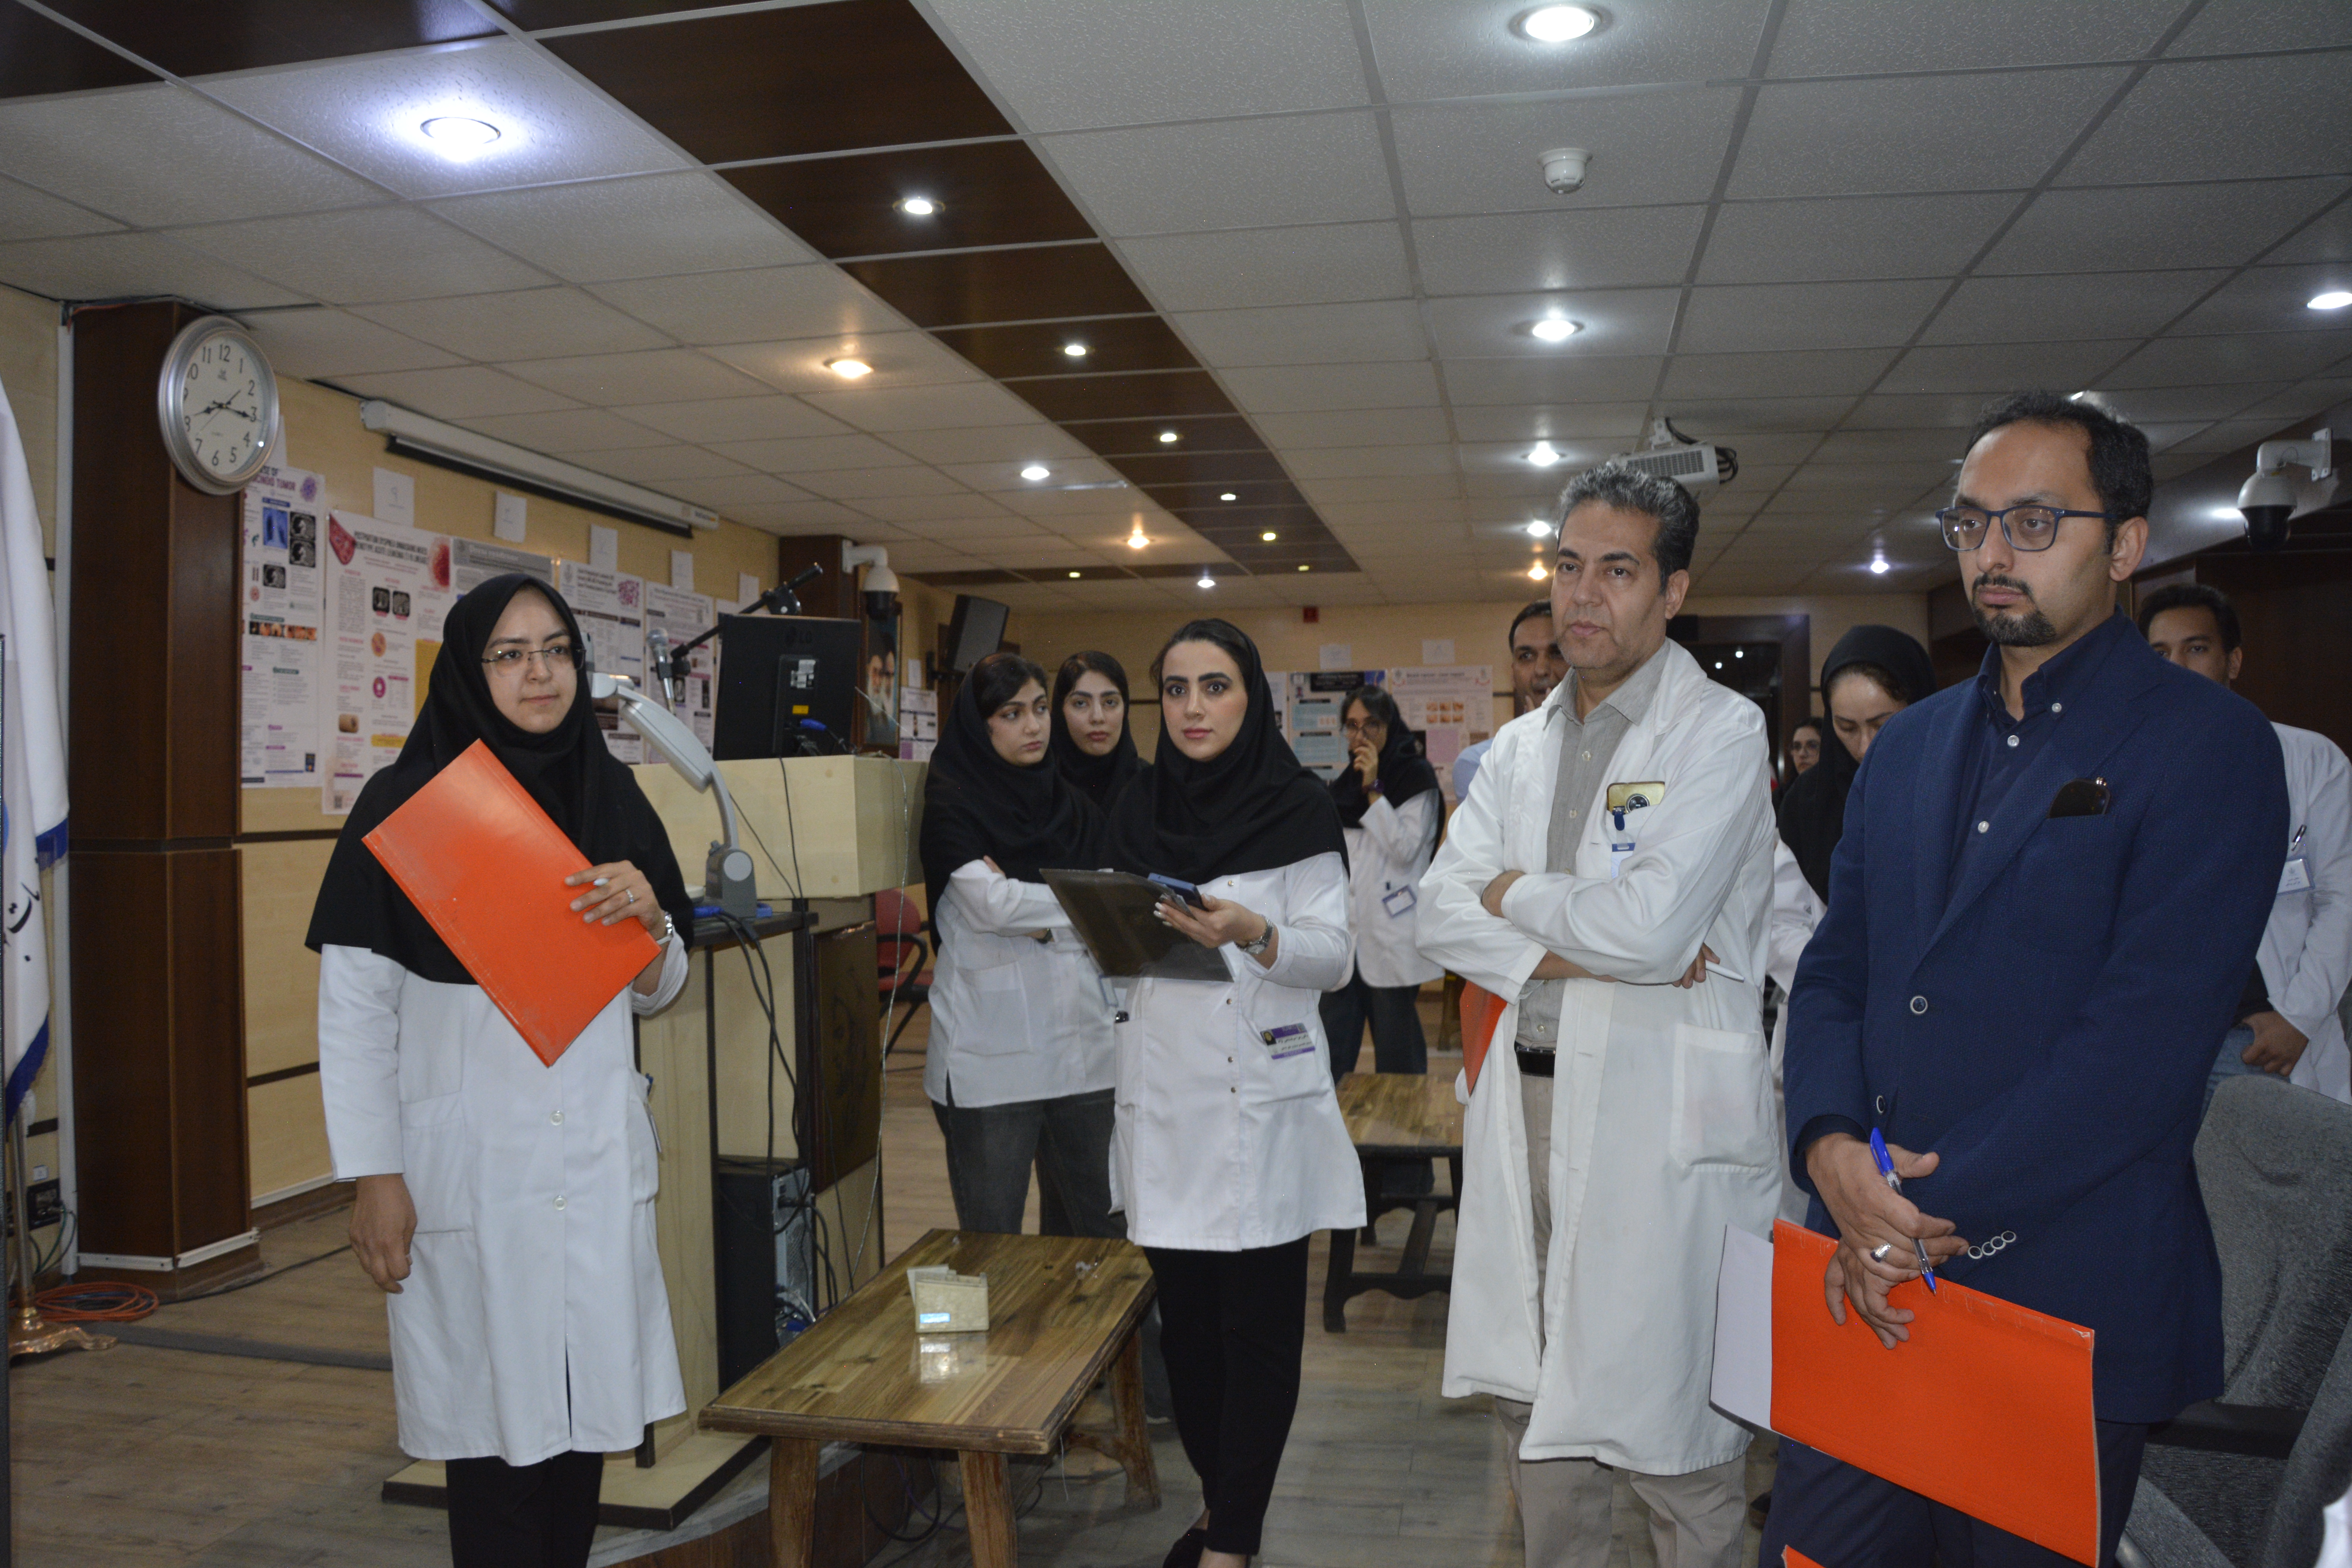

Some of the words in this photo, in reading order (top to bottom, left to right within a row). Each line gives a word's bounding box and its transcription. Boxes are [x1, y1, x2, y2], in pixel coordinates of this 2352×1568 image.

[203, 346, 211, 364] 11
[219, 344, 230, 362] 12
[187, 363, 198, 379] 10
[240, 358, 243, 374] 1
[248, 379, 255, 396] 2
[250, 406, 257, 422] 3
[185, 415, 191, 432] 8
[195, 438, 203, 454] 7
[243, 431, 251, 447] 4
[212, 450, 219, 466] 6
[229, 446, 237, 463] 5
